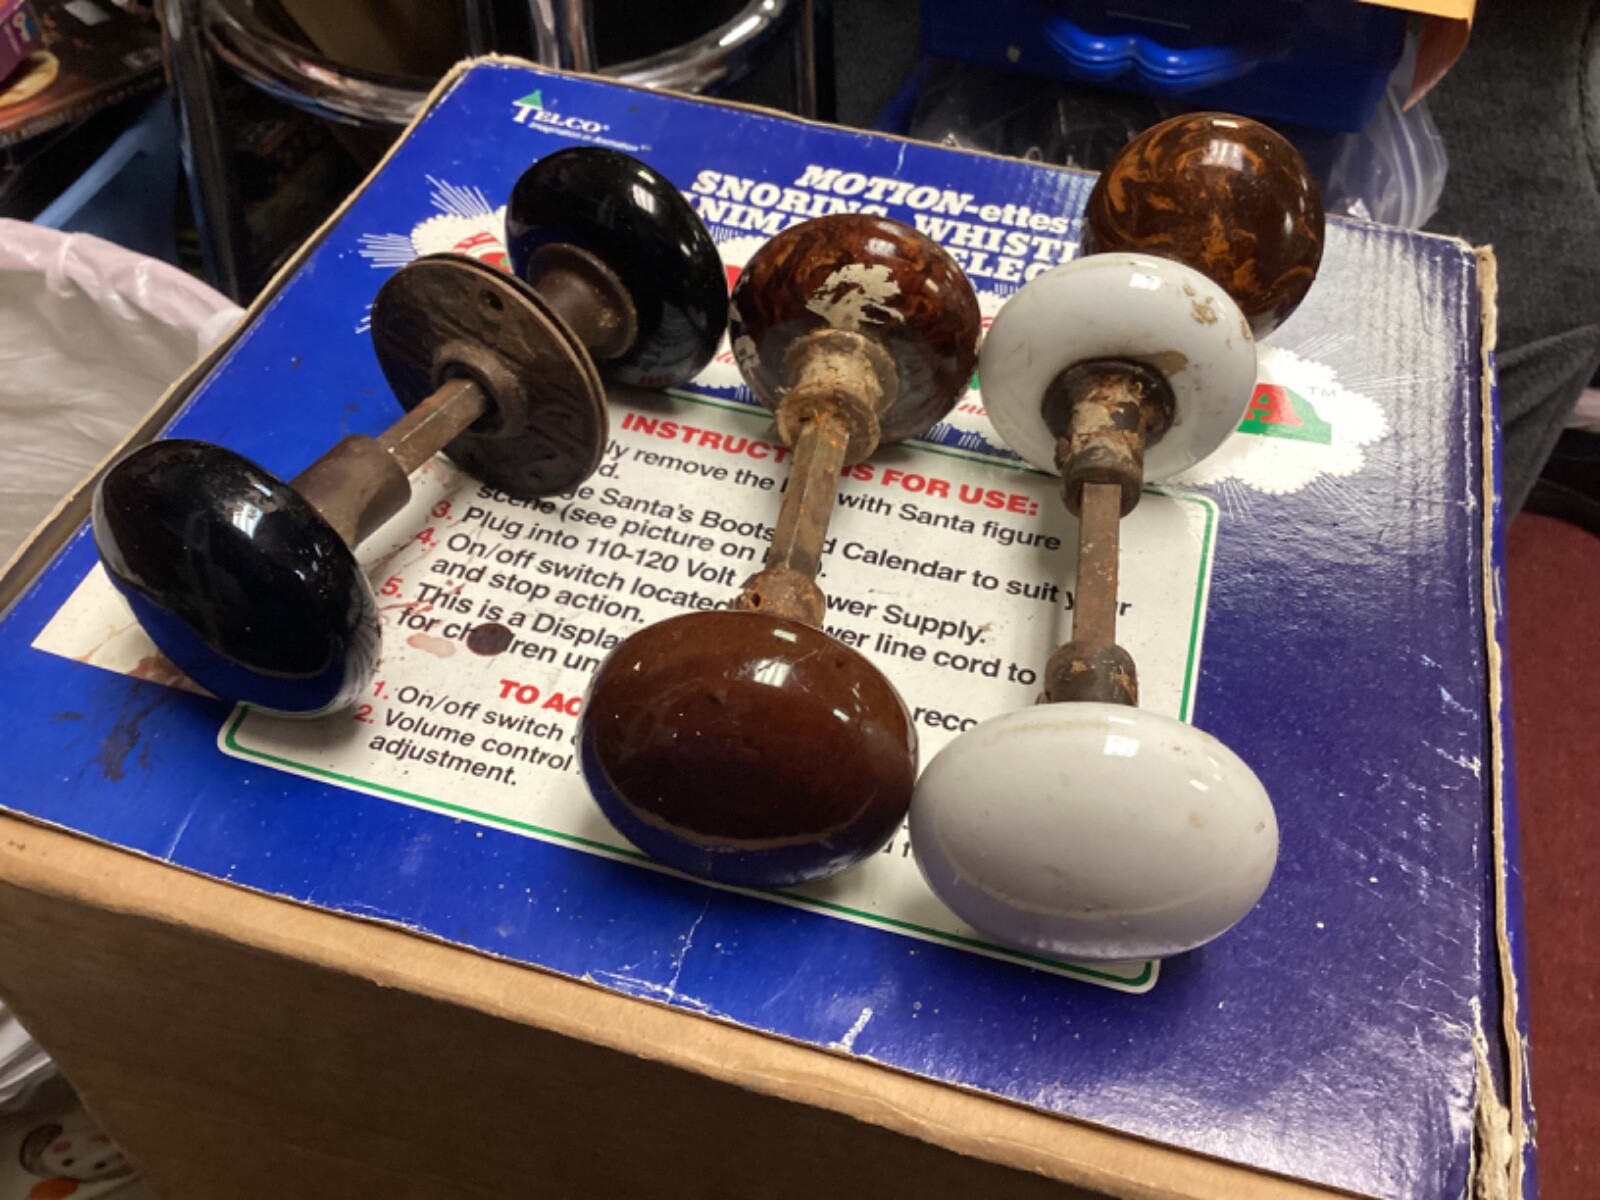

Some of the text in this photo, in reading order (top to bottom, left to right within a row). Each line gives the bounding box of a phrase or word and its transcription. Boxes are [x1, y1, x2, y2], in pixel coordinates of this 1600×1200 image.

[795, 164, 1069, 234] MOTION-ettes
[633, 448, 728, 480] remove
[734, 469, 775, 492] the
[837, 492, 892, 516] with
[899, 503, 975, 534] Santa
[982, 520, 1061, 551] figure
[881, 468, 951, 498] FOR
[958, 484, 1039, 516] USE:
[431, 499, 452, 520] 3.
[462, 506, 524, 540] Plug
[527, 523, 579, 550] into
[586, 537, 679, 573] 110-120
[687, 558, 737, 587] Volt
[560, 502, 617, 529] (see
[619, 519, 714, 551] picture
[720, 542, 756, 561] on
[600, 487, 694, 523] Santa's
[842, 542, 966, 583] Calendar
[972, 570, 999, 590] to
[1005, 580, 1060, 603] suit
[397, 607, 442, 632] for
[414, 527, 437, 547] 4.
[447, 533, 536, 568] On/off
[536, 558, 625, 591] switch
[882, 604, 986, 646] Supply.
[431, 558, 645, 623] and stop action.
[380, 575, 403, 598] 5.
[417, 582, 473, 614] This
[477, 599, 503, 621] is
[508, 611, 527, 627] a
[531, 612, 625, 650] Displa
[874, 632, 926, 662] line
[933, 649, 1002, 678] cord
[1007, 662, 1037, 685] to
[373, 680, 564, 741] 1. On/off switch
[499, 678, 540, 704] TO
[352, 704, 573, 771] 2. Volume control
[368, 735, 516, 785] adjustment.
